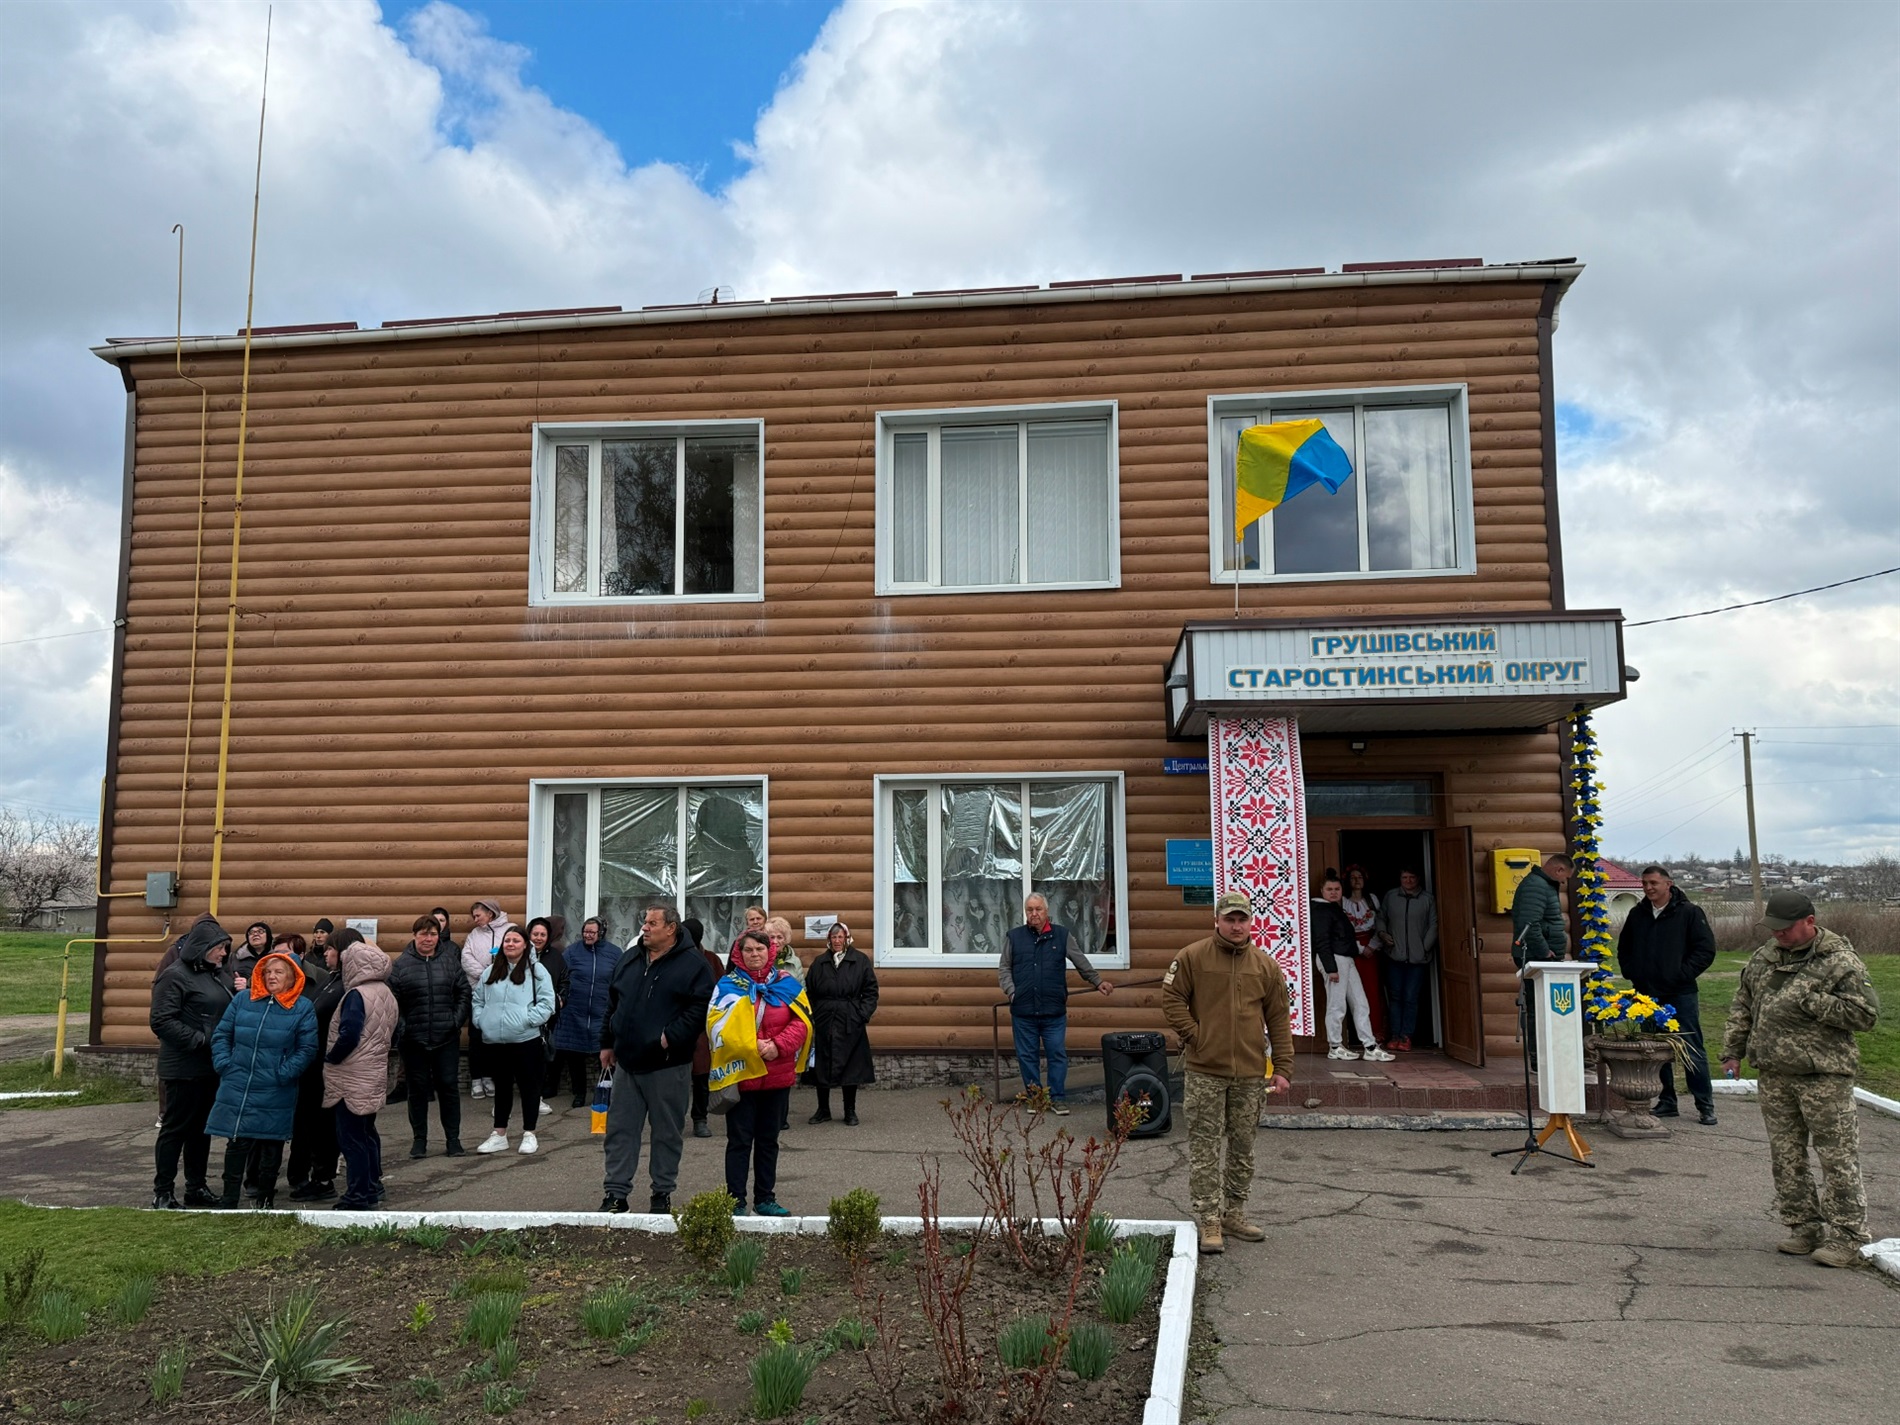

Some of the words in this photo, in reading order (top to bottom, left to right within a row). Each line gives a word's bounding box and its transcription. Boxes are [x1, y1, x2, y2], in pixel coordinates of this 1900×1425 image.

[1311, 628, 1496, 656] ГРУШІВСЬКИЙ
[1228, 661, 1495, 688] СТАРОСТИНСЬКИЙ
[1505, 660, 1588, 682] ОКРУГ
[1171, 760, 1210, 773] Центральн
